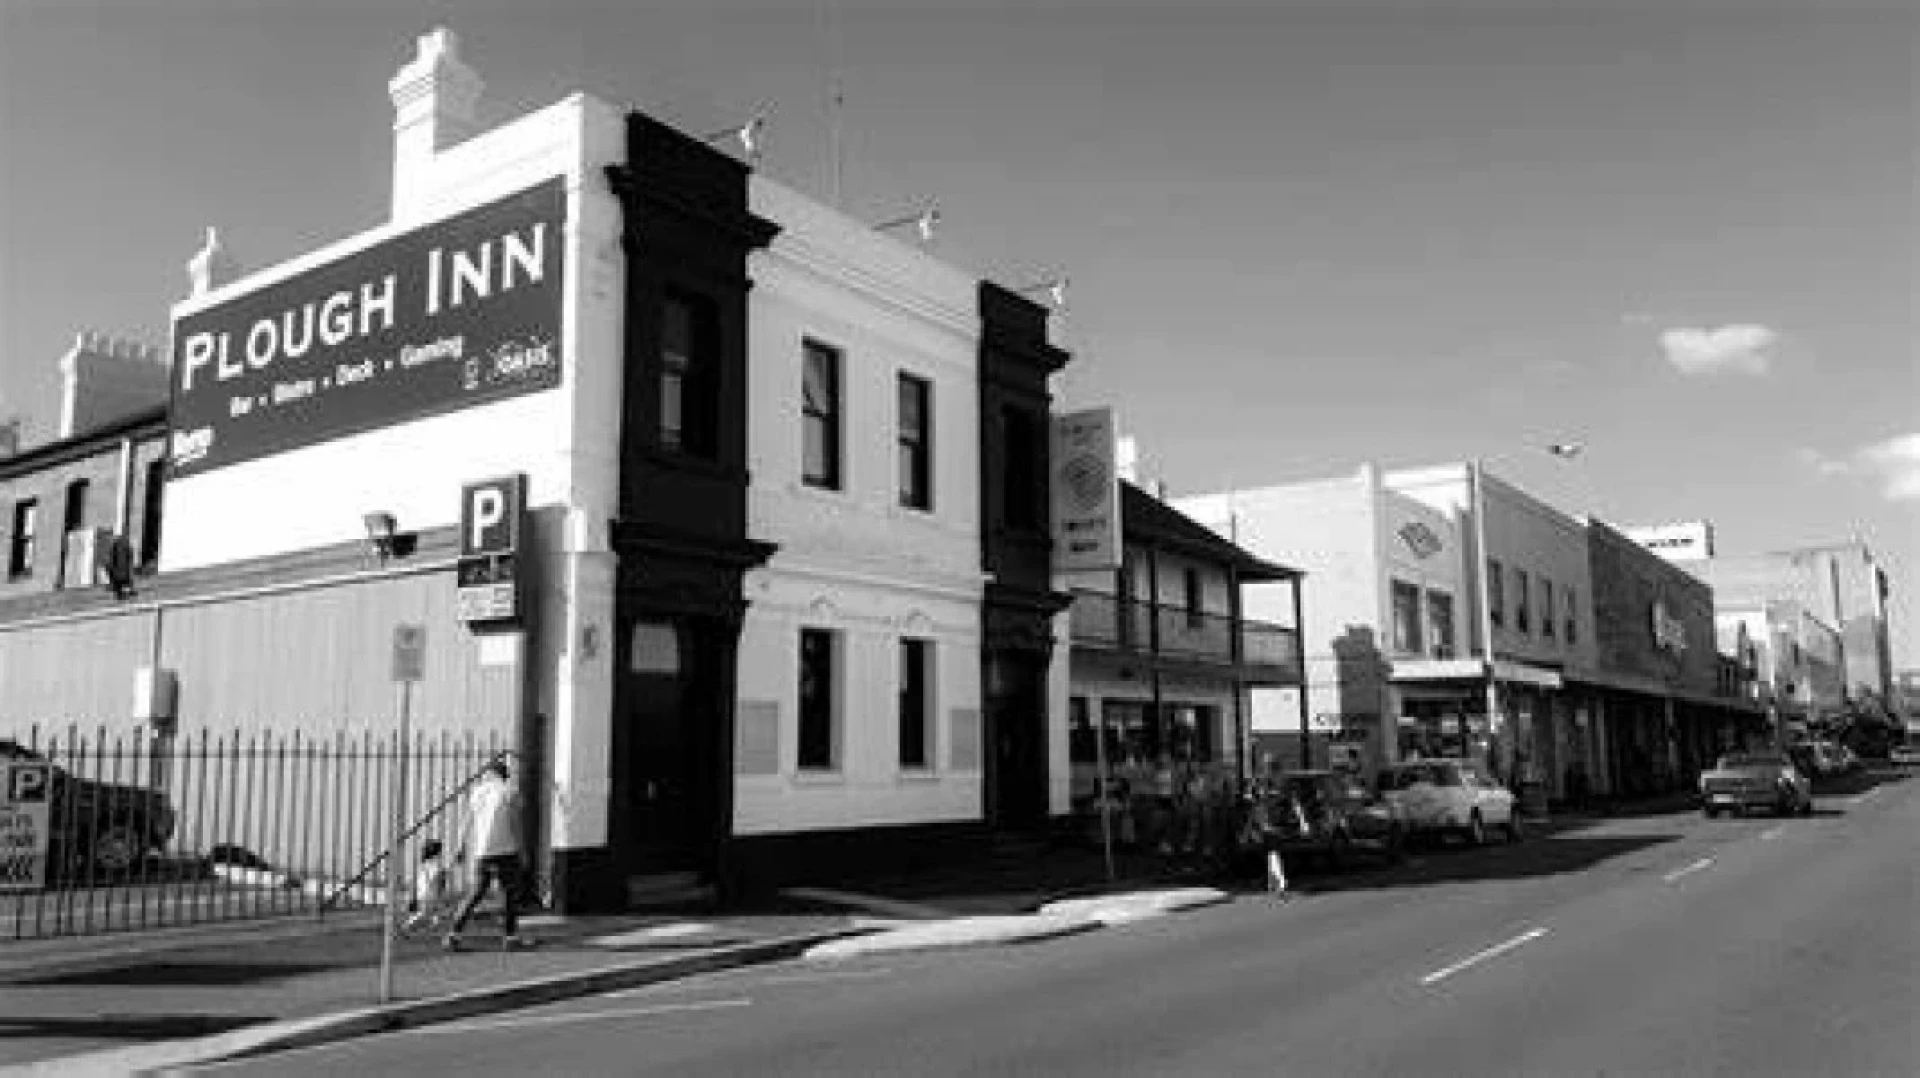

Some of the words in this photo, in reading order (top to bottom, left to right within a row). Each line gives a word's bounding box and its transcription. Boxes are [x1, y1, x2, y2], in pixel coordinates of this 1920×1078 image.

[182, 274, 395, 391] PLOUGH
[426, 222, 546, 316] INN
[473, 489, 503, 549] P
[16, 770, 42, 799] P
